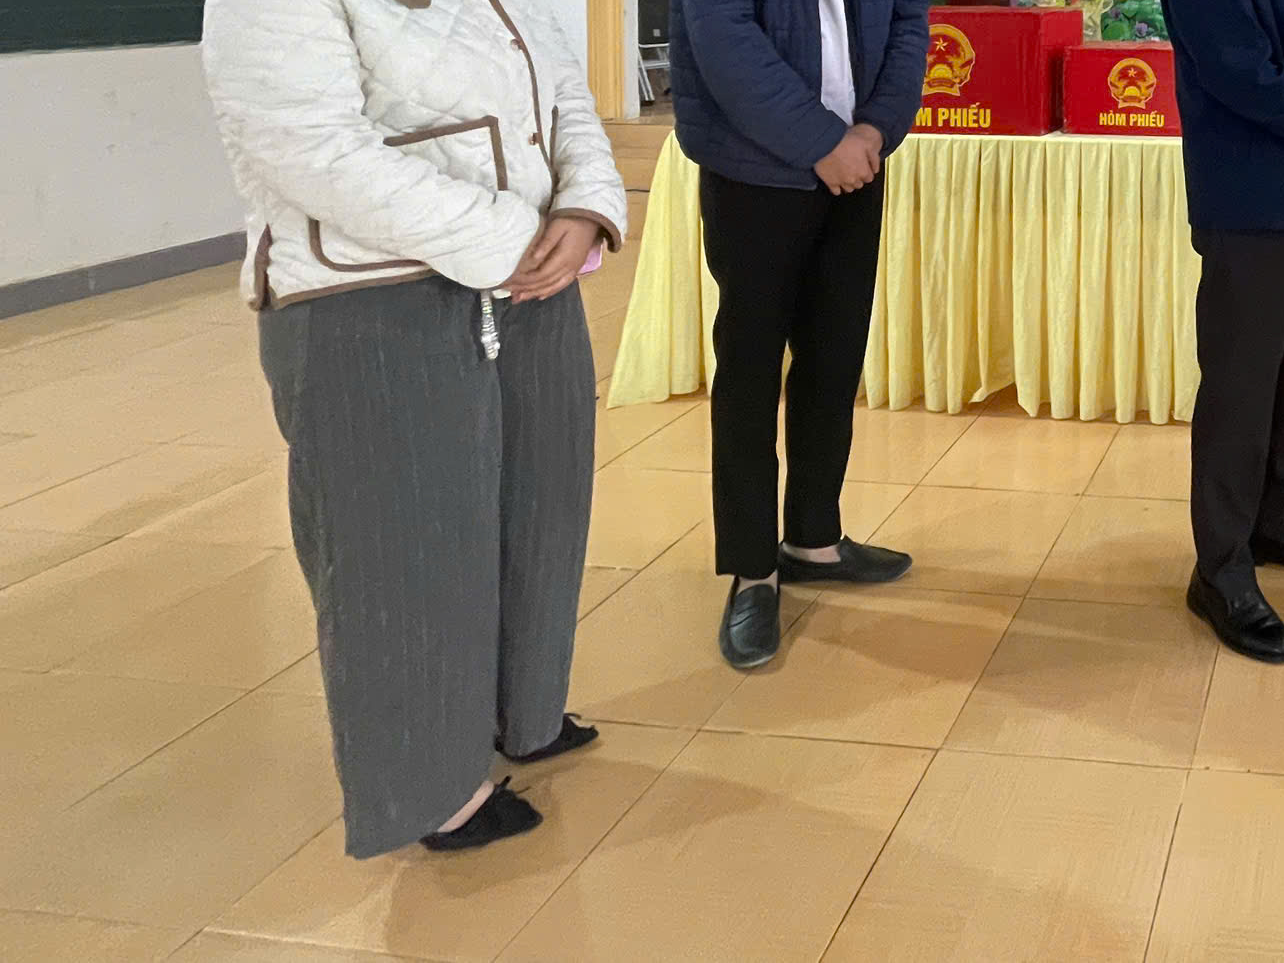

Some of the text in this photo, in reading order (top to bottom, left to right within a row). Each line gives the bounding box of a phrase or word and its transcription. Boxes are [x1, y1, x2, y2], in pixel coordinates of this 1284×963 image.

[937, 102, 992, 129] PHIẾU
[1099, 110, 1166, 128] HÒM PHIẾU
